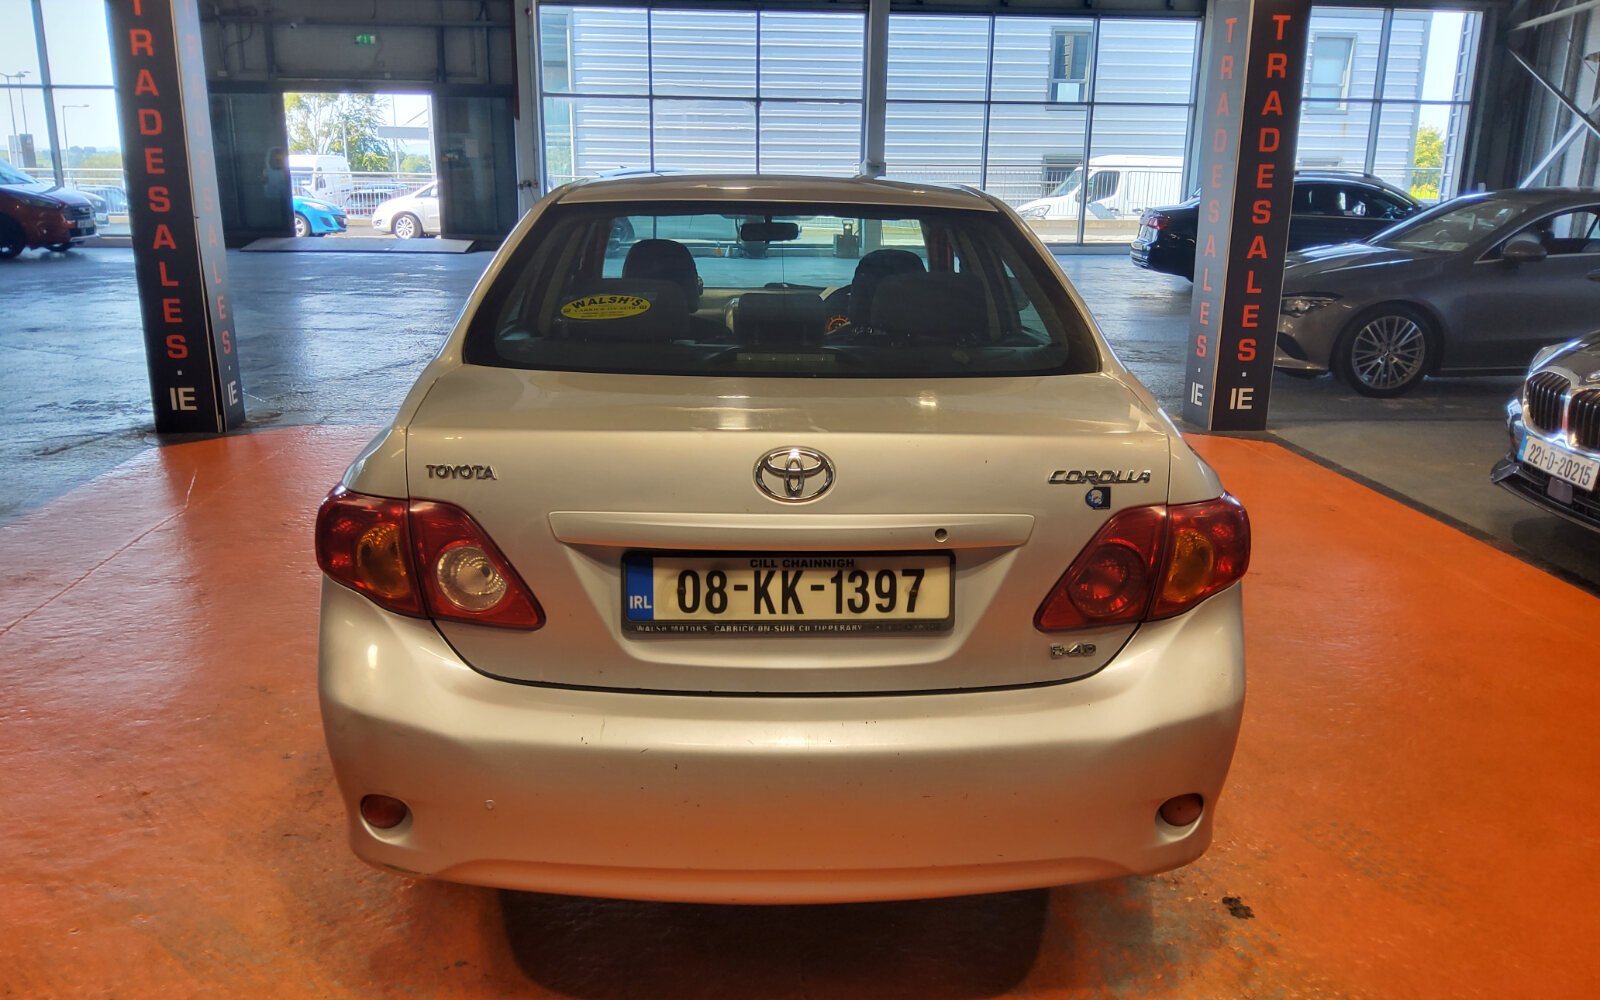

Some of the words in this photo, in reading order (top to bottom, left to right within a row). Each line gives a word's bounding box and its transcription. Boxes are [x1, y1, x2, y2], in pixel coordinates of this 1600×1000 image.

[571, 296, 644, 310] WALSH'S
[426, 464, 498, 480] TOYOTA
[1527, 443, 1593, 486] 221-D-20215
[1048, 469, 1152, 485] COROLLA
[749, 559, 778, 568] CILL
[782, 559, 855, 568] CHAINNIGH
[676, 568, 926, 615] 08-KK-1397
[629, 595, 652, 609] IRL
[814, 624, 863, 632] TIPPERARY
